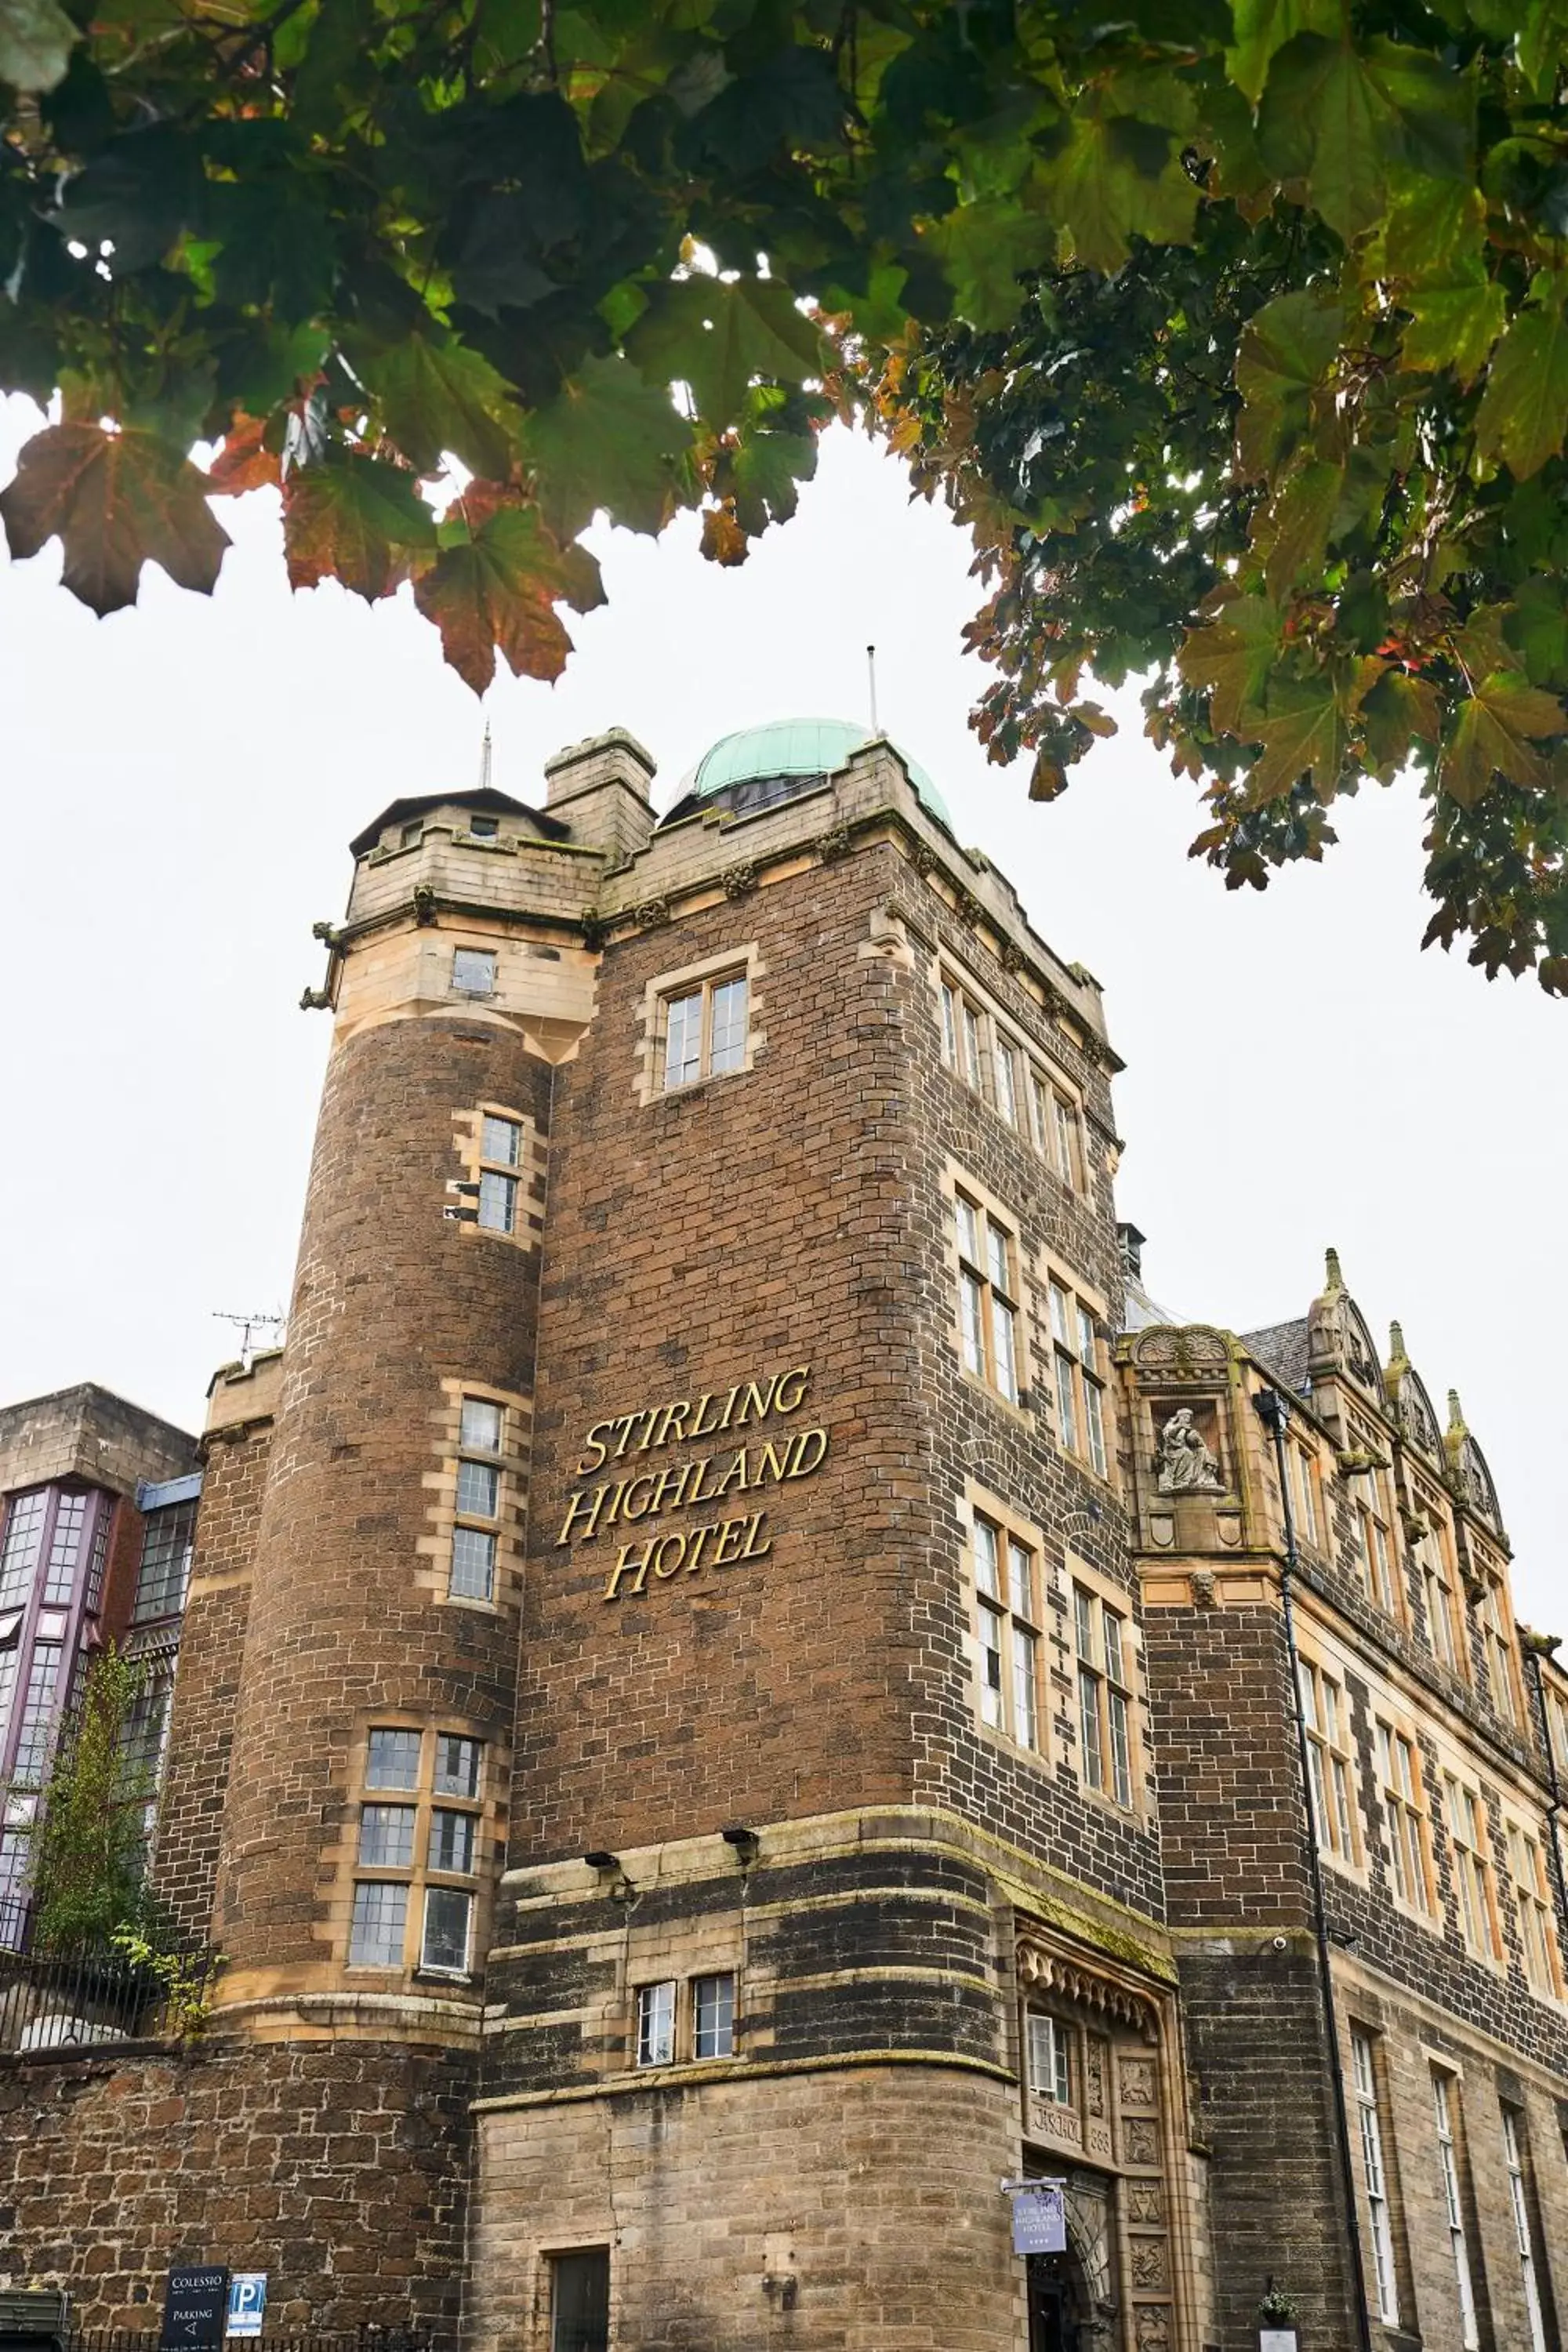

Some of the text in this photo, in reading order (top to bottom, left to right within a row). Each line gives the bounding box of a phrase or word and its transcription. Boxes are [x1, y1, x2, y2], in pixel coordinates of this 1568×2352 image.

[576, 1366, 811, 1475] STIRLING
[554, 1428, 829, 1547] HIGHLAND
[603, 1512, 771, 1602] HOTEL
[172, 2275, 222, 2288] COLESSIO
[238, 2282, 256, 2312] P
[172, 2309, 212, 2321] PARKING
